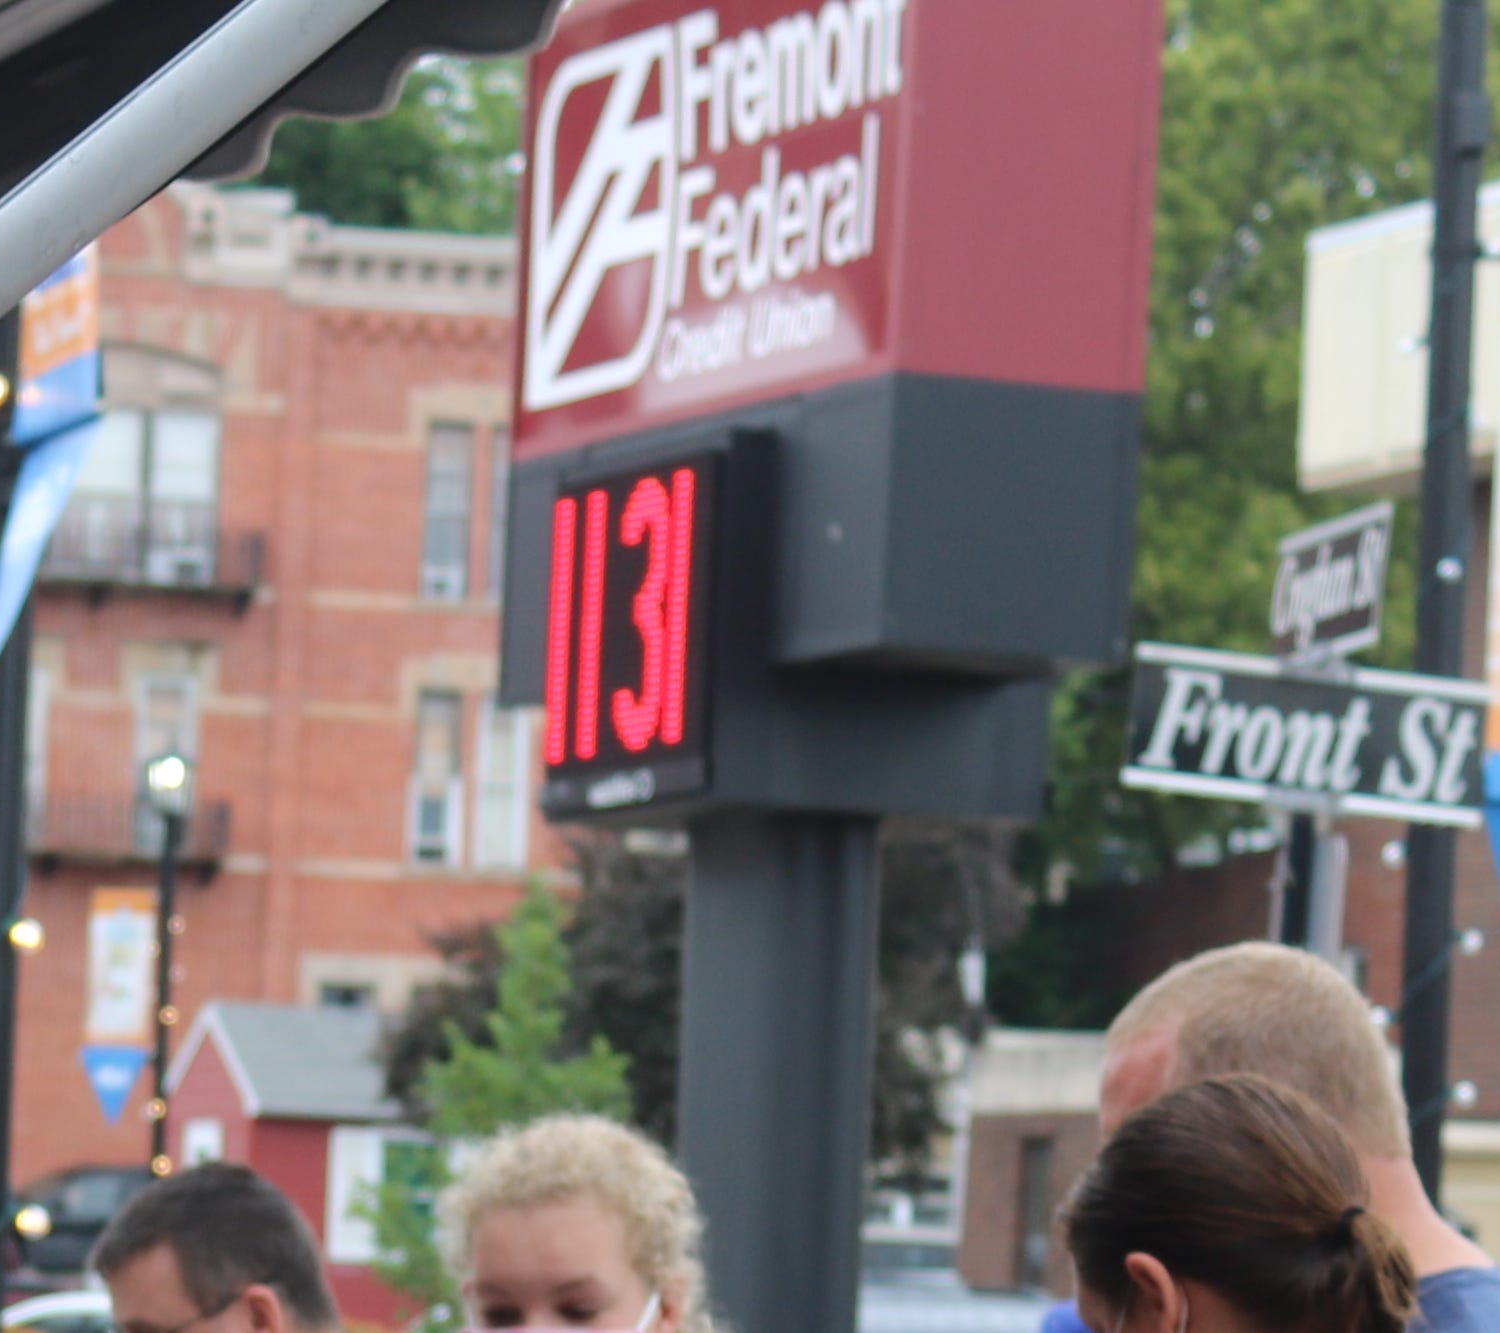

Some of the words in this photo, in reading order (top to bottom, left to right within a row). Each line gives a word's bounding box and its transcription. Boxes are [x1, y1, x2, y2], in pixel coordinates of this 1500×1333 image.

[678, 0, 909, 162] Fremont
[669, 112, 881, 309] Federal
[658, 305, 746, 382] Credit
[749, 288, 836, 357] Union
[1138, 667, 1372, 791] Front
[1378, 696, 1478, 804] St
